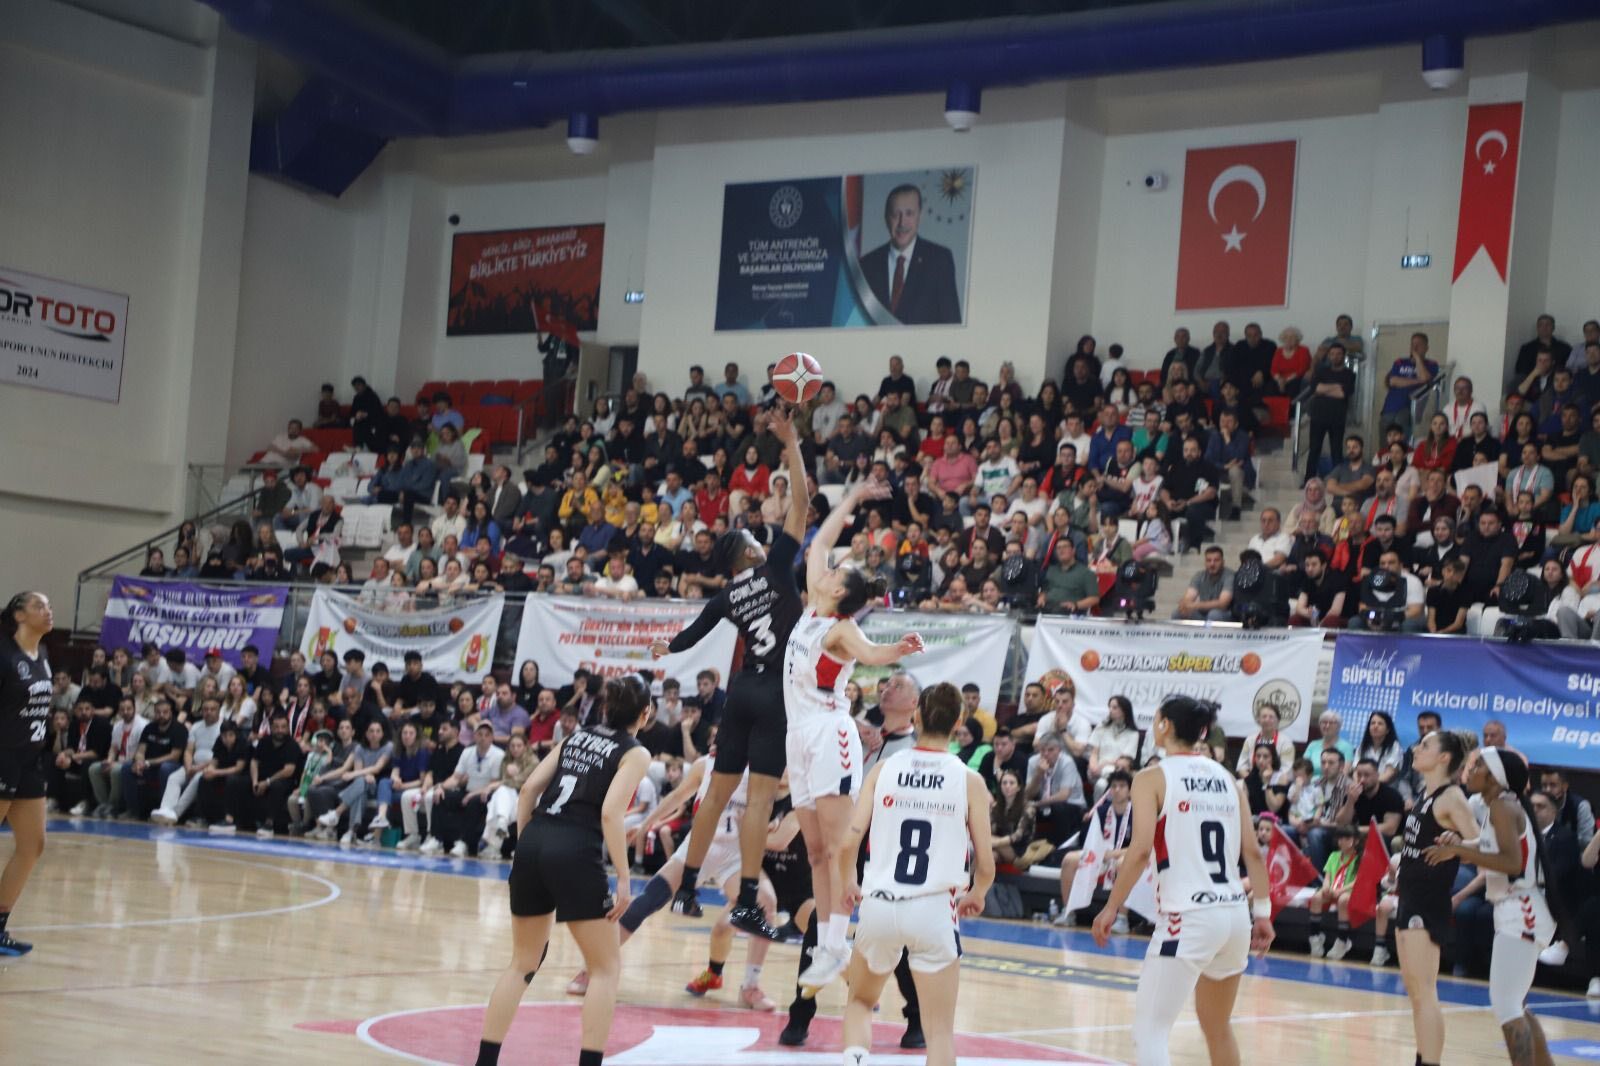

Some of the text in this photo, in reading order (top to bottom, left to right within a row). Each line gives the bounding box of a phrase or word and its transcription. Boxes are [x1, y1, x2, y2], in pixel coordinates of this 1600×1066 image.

[470, 255, 518, 280] BİRLİKTE
[17, 365, 39, 379] 2024
[128, 620, 253, 650] KOŞUYORUZ
[747, 613, 776, 656] 3
[1099, 650, 1241, 673] ADIM ADIM SÜPER LİGE
[1359, 649, 1398, 669] Hedef
[1342, 664, 1405, 687] SÜPER LİG
[1411, 690, 1488, 710] Kırklareli
[1493, 694, 1589, 720] Belediyesi
[898, 769, 944, 789] UĞUR
[546, 774, 578, 815] 7
[894, 819, 932, 885] 8
[1201, 821, 1229, 883] 9
